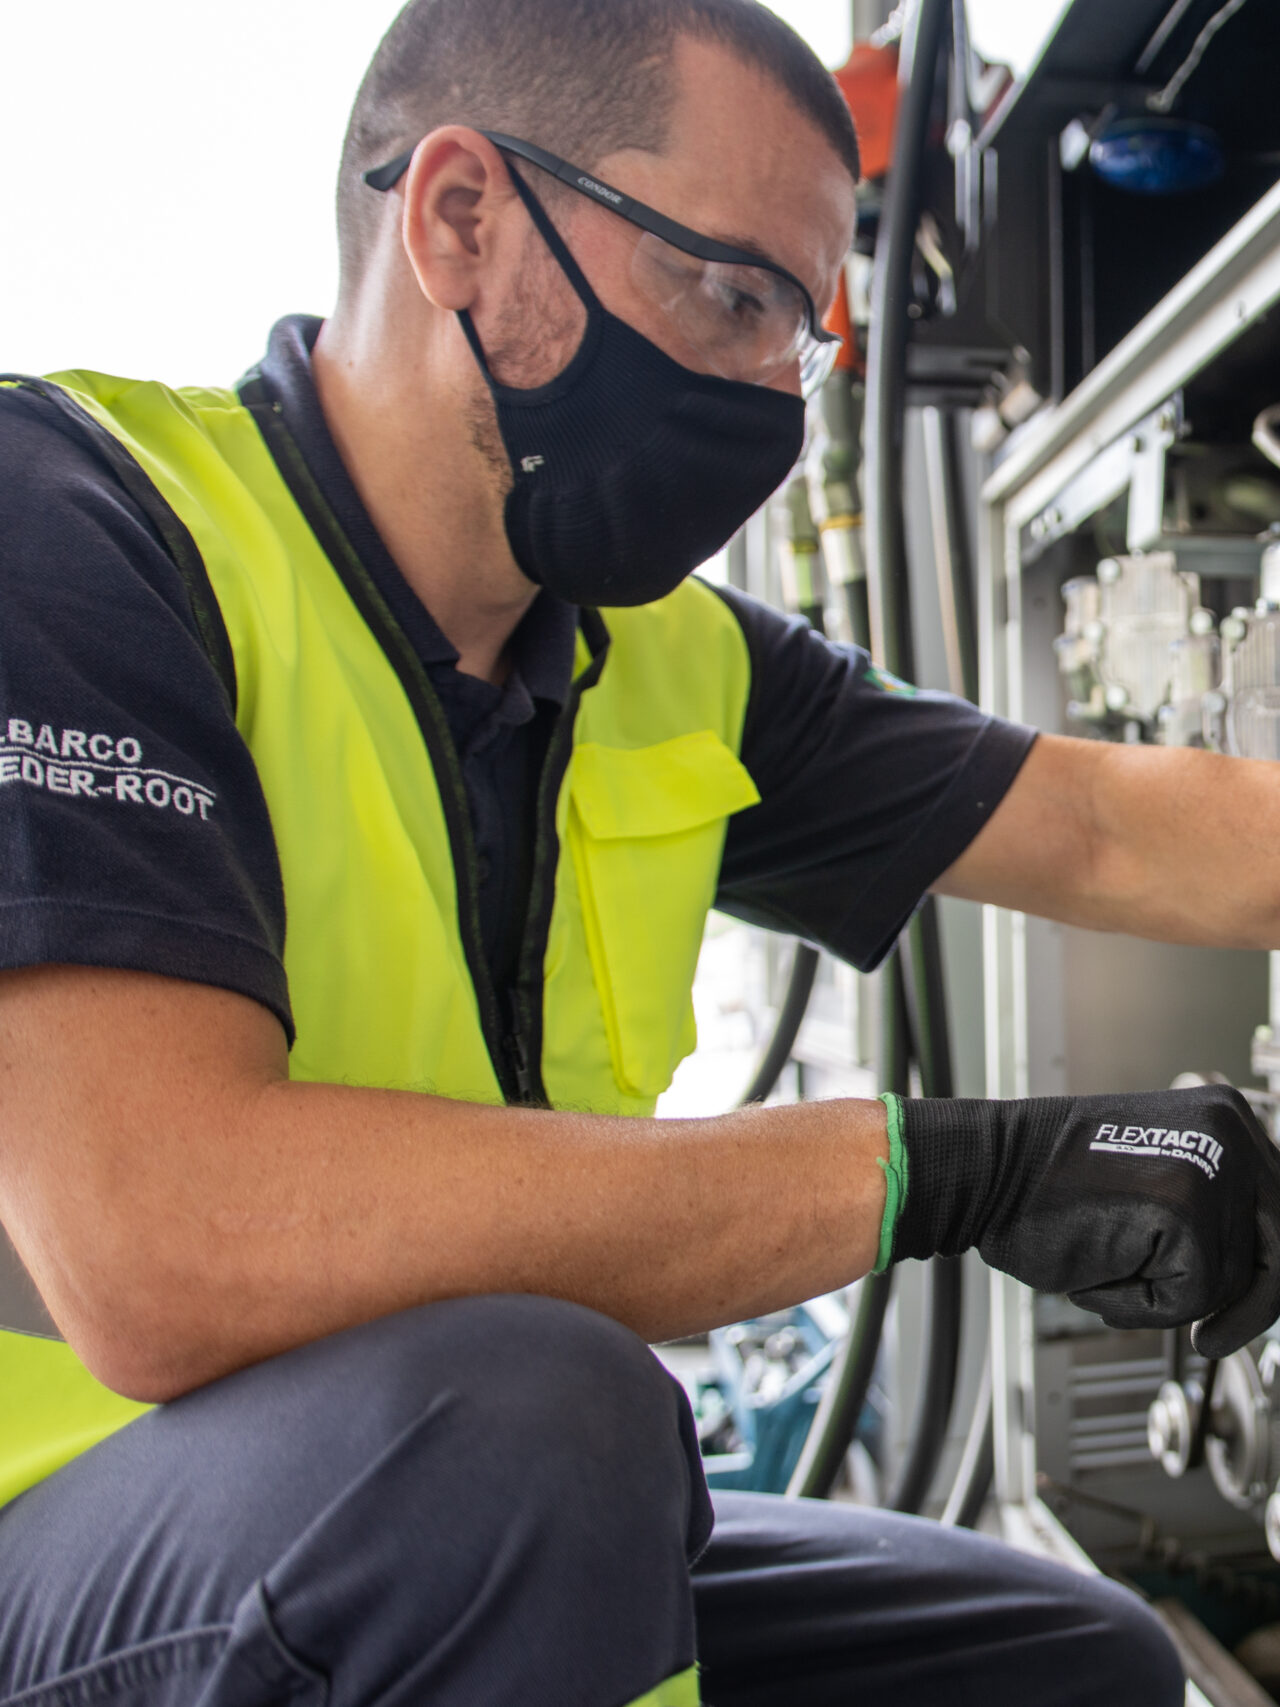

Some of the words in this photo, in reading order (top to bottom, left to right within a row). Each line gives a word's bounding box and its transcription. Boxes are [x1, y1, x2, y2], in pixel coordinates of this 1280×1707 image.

[577, 176, 623, 204] CONDOR
[0, 719, 143, 764] BARCO
[1095, 1123, 1224, 1172] FLEXTACTIL
[1171, 1149, 1217, 1181] DANNY
